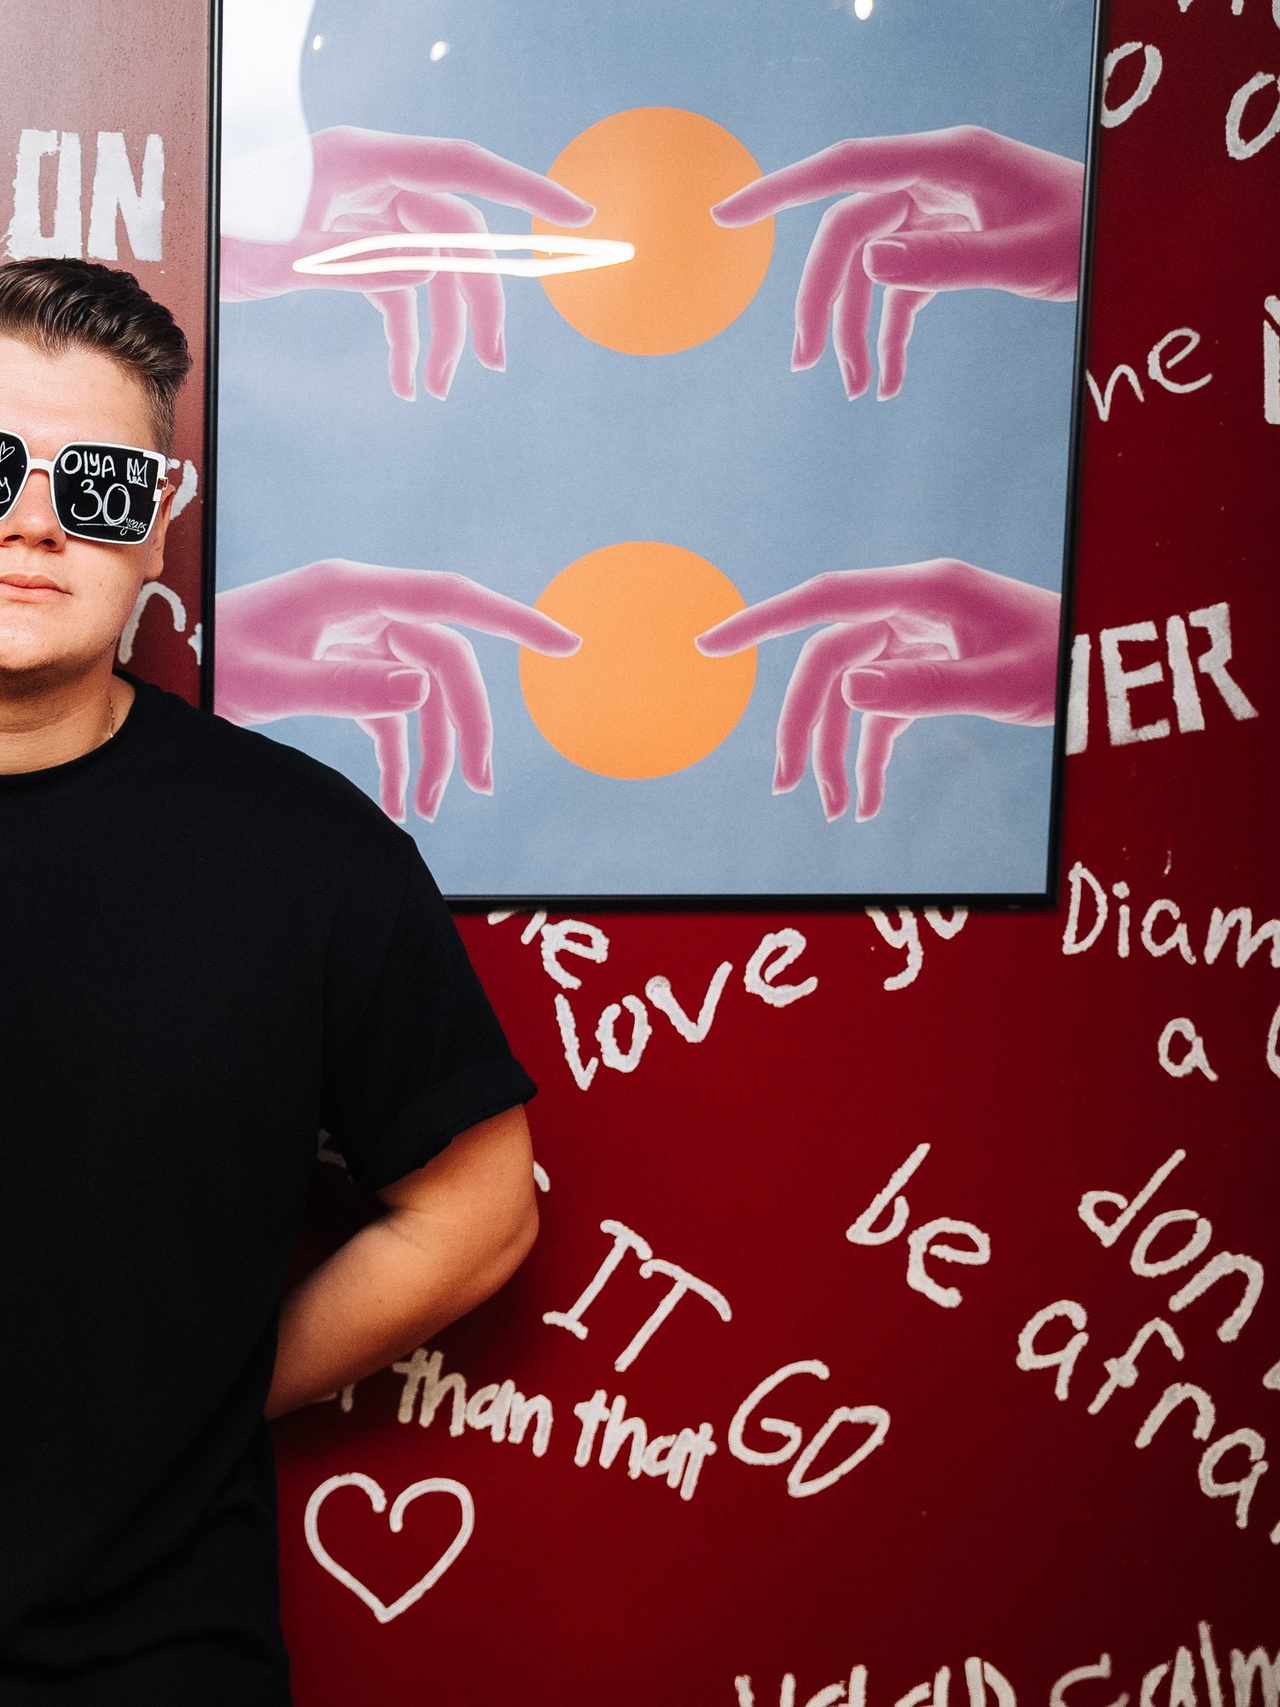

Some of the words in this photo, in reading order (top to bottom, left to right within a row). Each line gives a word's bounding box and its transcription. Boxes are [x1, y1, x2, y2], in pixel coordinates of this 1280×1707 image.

[1, 128, 165, 262] ON
[70, 479, 131, 526] 30
[555, 928, 819, 1091] love
[846, 1142, 991, 1308] be
[1016, 1299, 1280, 1545] afra
[1077, 1148, 1280, 1389] don
[392, 1347, 554, 1458] than
[573, 1389, 718, 1501] that
[542, 1219, 732, 1372] IT
[727, 1359, 891, 1498] GO
